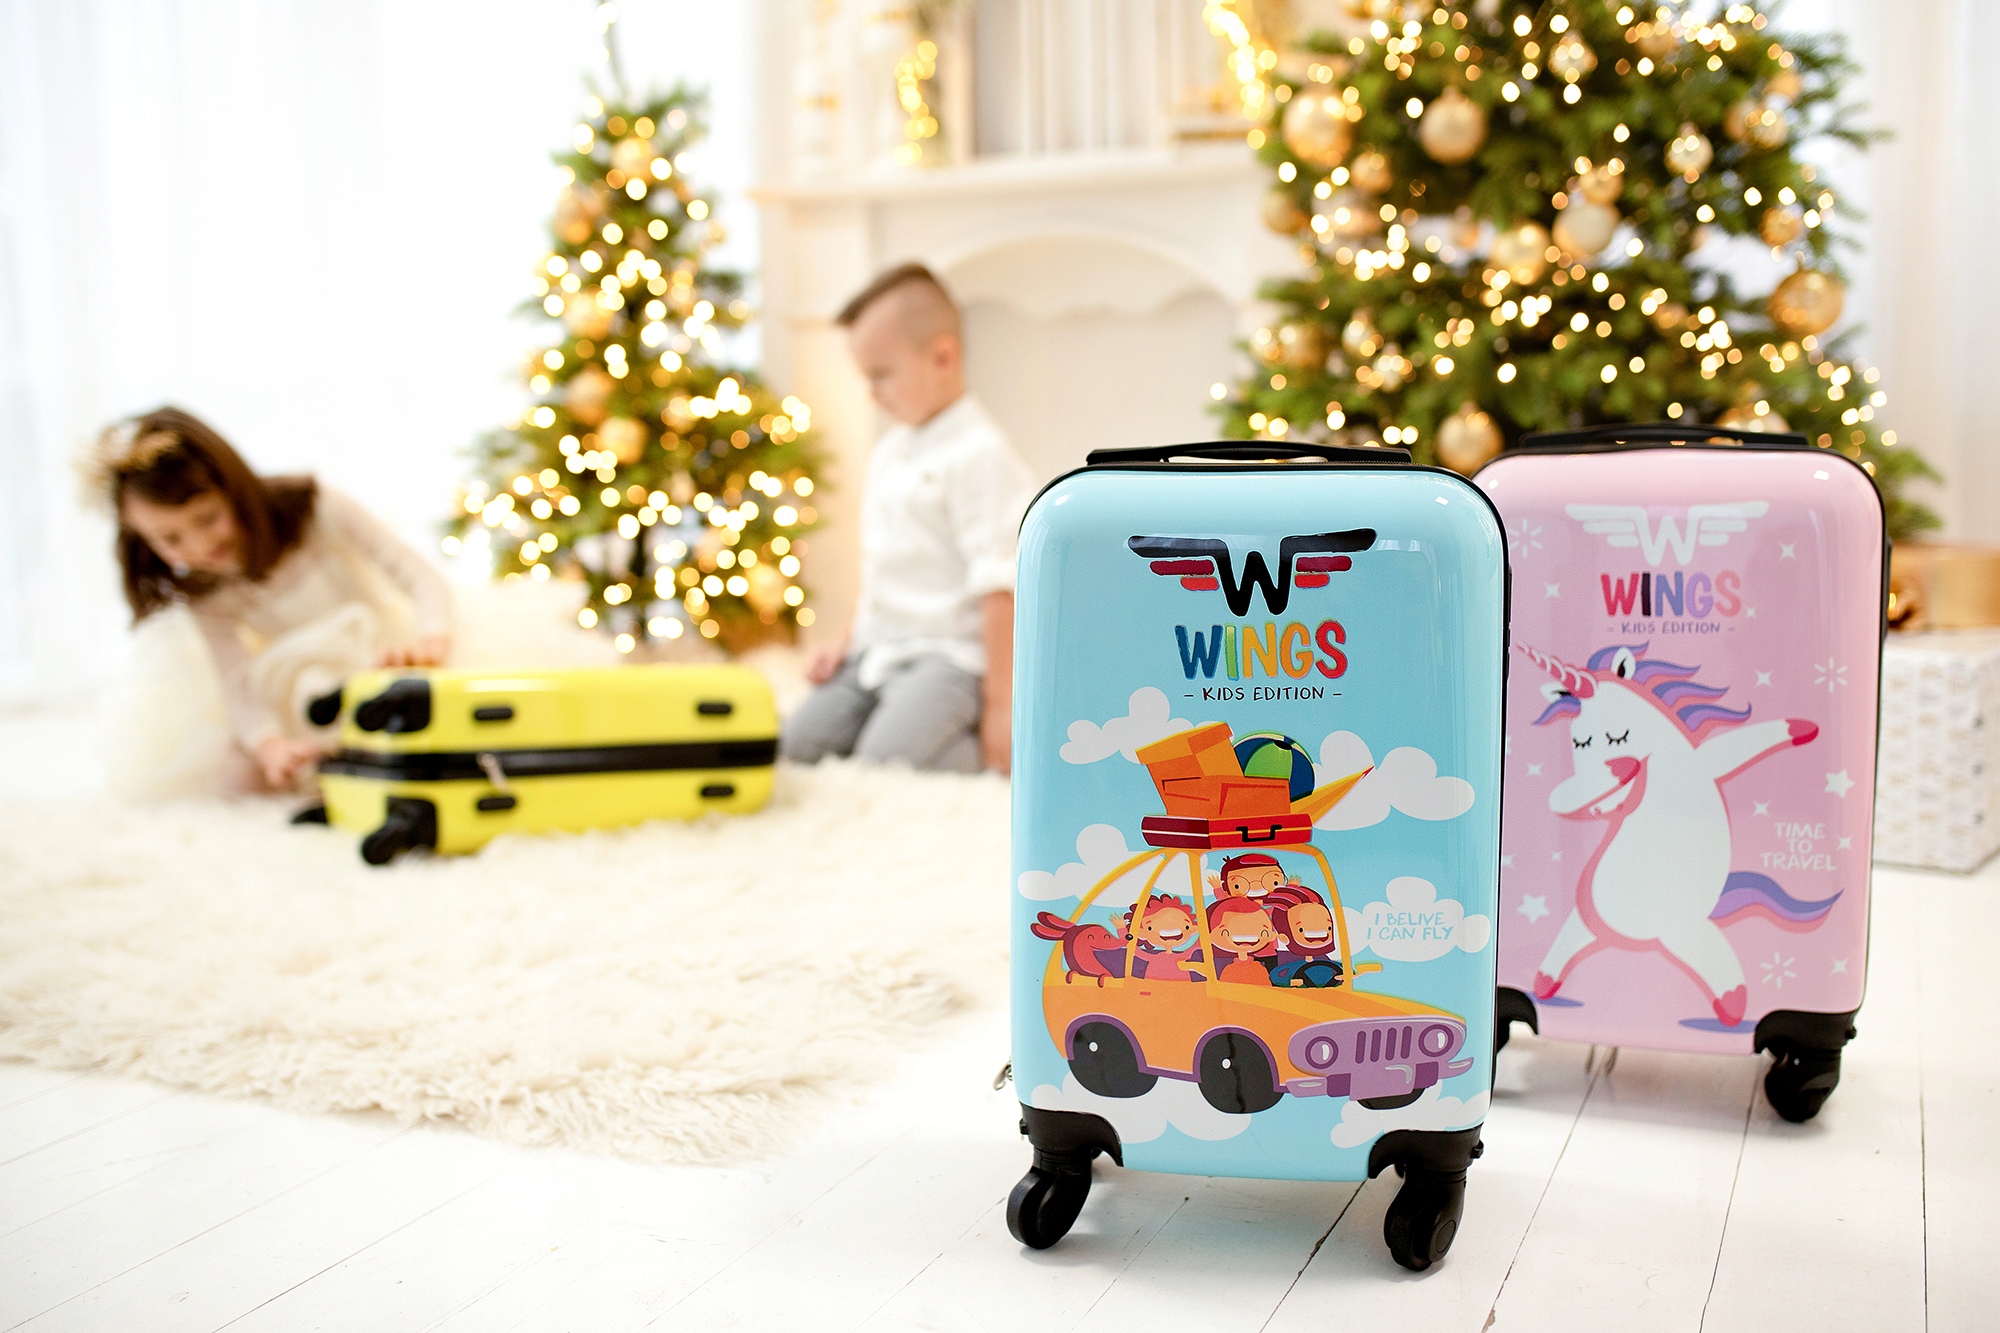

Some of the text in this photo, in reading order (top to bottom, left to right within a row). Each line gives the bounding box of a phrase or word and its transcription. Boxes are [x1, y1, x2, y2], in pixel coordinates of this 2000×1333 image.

[1600, 570, 1742, 619] WINGS
[1621, 621, 1656, 634] KIDS
[1661, 621, 1721, 634] EDITION
[1174, 619, 1348, 681] WINGS
[1202, 686, 1245, 701] KIDS
[1253, 686, 1325, 700] EDITION
[1775, 822, 1826, 839] TIME
[1787, 837, 1813, 854] TO
[1760, 851, 1837, 870] TRAVEL
[1375, 912, 1446, 926] I BELIVE
[1367, 926, 1454, 941] I CAN FLY
